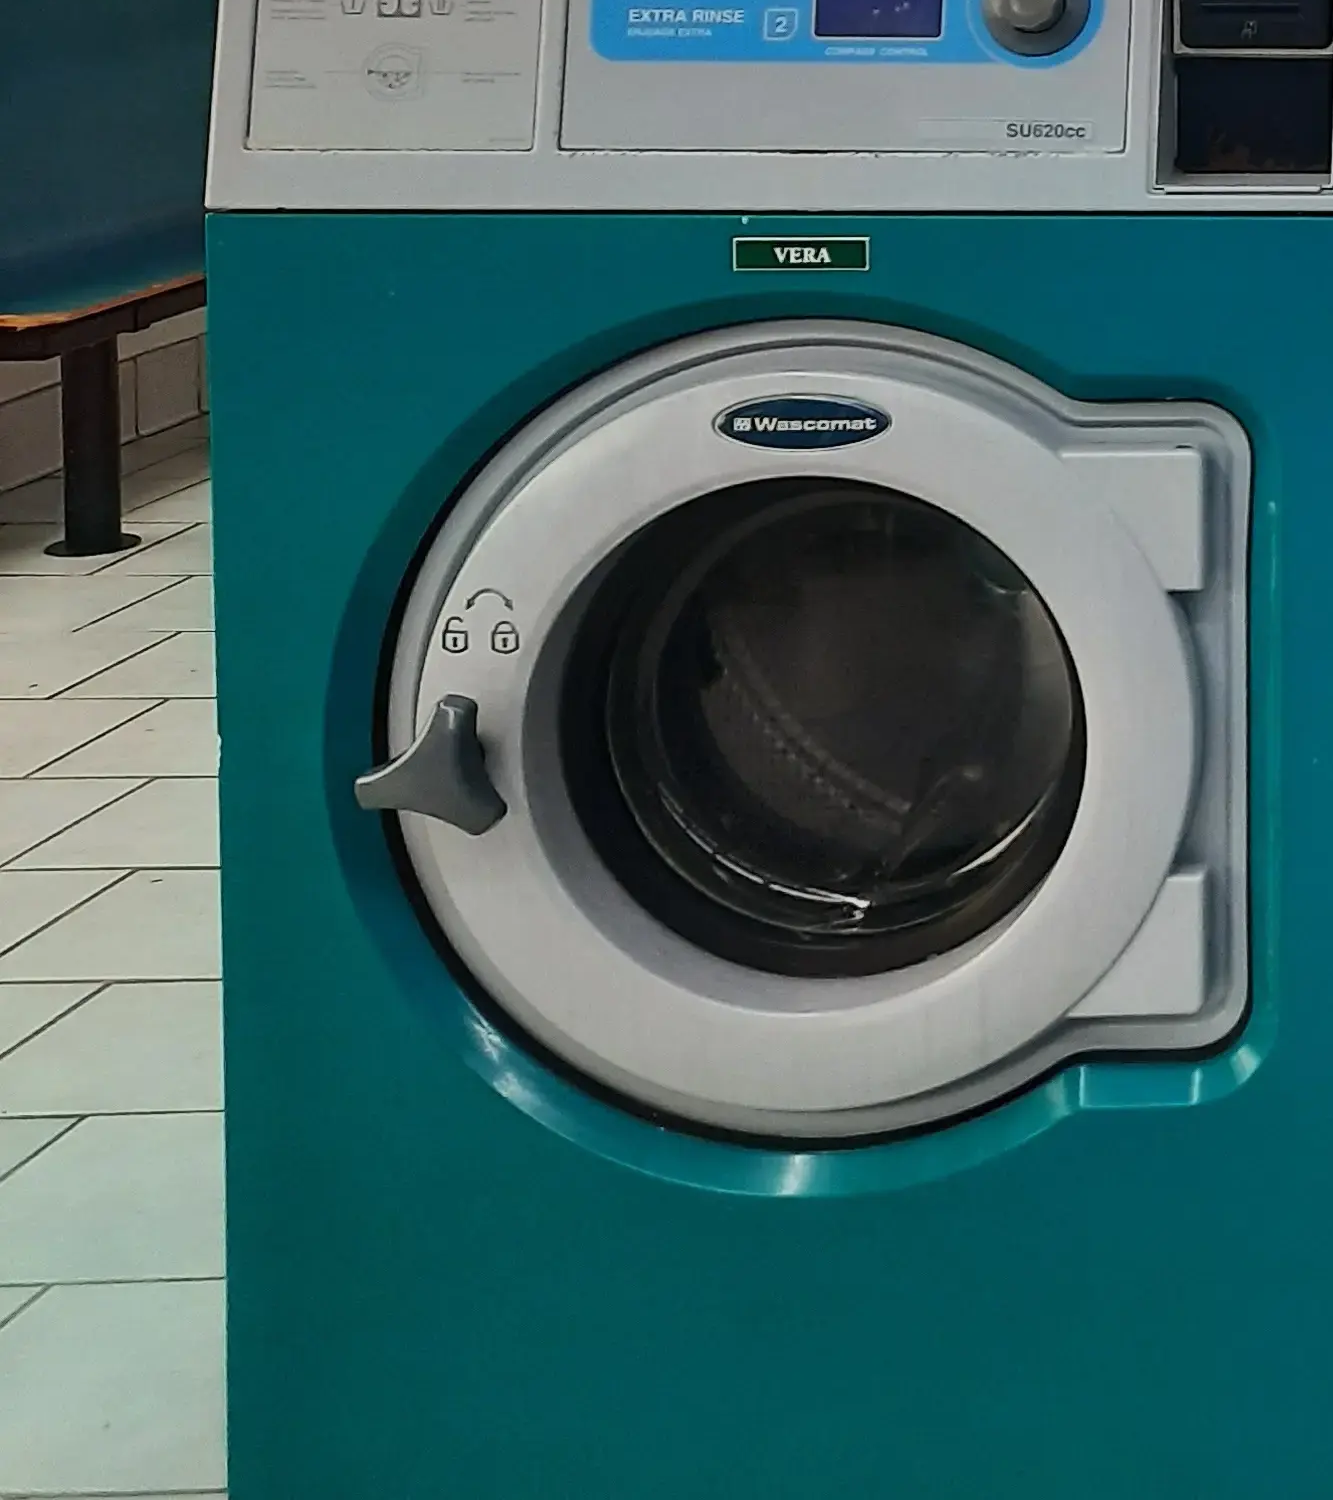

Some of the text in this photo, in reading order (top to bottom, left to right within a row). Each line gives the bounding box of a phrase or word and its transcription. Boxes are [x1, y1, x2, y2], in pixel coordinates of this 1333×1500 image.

[629, 8, 745, 23] EXTRA RINSE
[775, 15, 788, 33] 2
[1006, 123, 1086, 138] SU620cc
[773, 246, 832, 263] VERA
[753, 417, 877, 431] Wascomat
